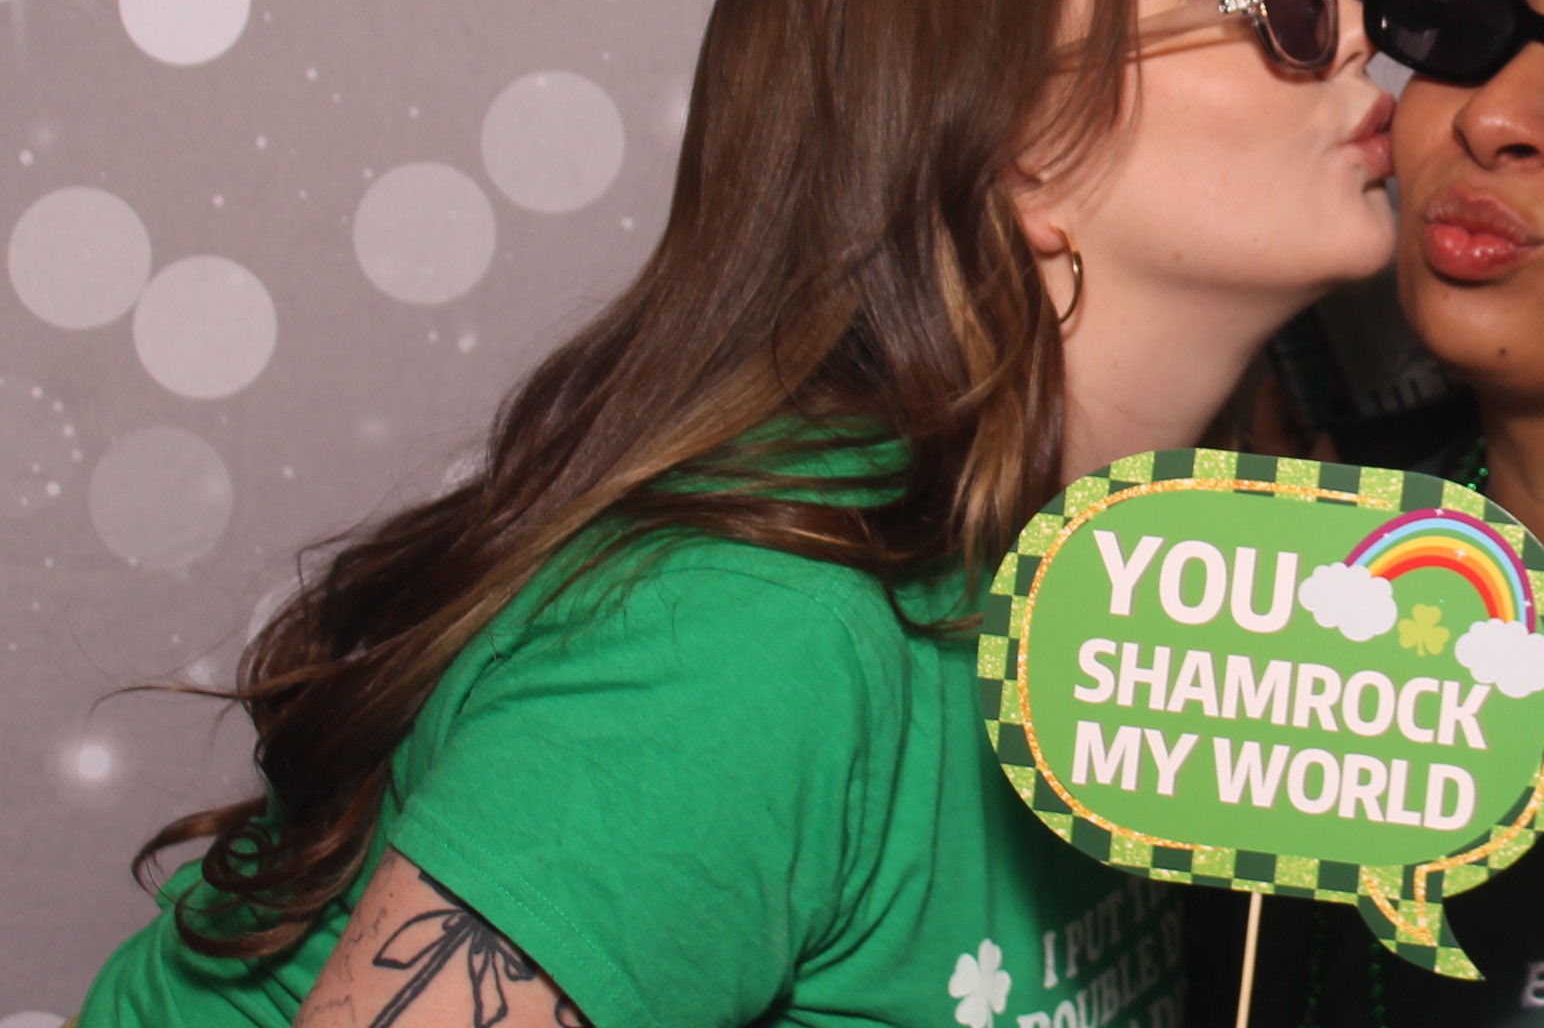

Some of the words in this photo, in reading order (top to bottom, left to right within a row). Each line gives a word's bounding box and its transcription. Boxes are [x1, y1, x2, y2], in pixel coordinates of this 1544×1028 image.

[1092, 528, 1299, 634] YOU
[1073, 637, 1491, 750] SHAMROCK
[1070, 719, 1199, 796] MY
[1212, 736, 1477, 831] WORLD
[1042, 930, 1059, 990] I
